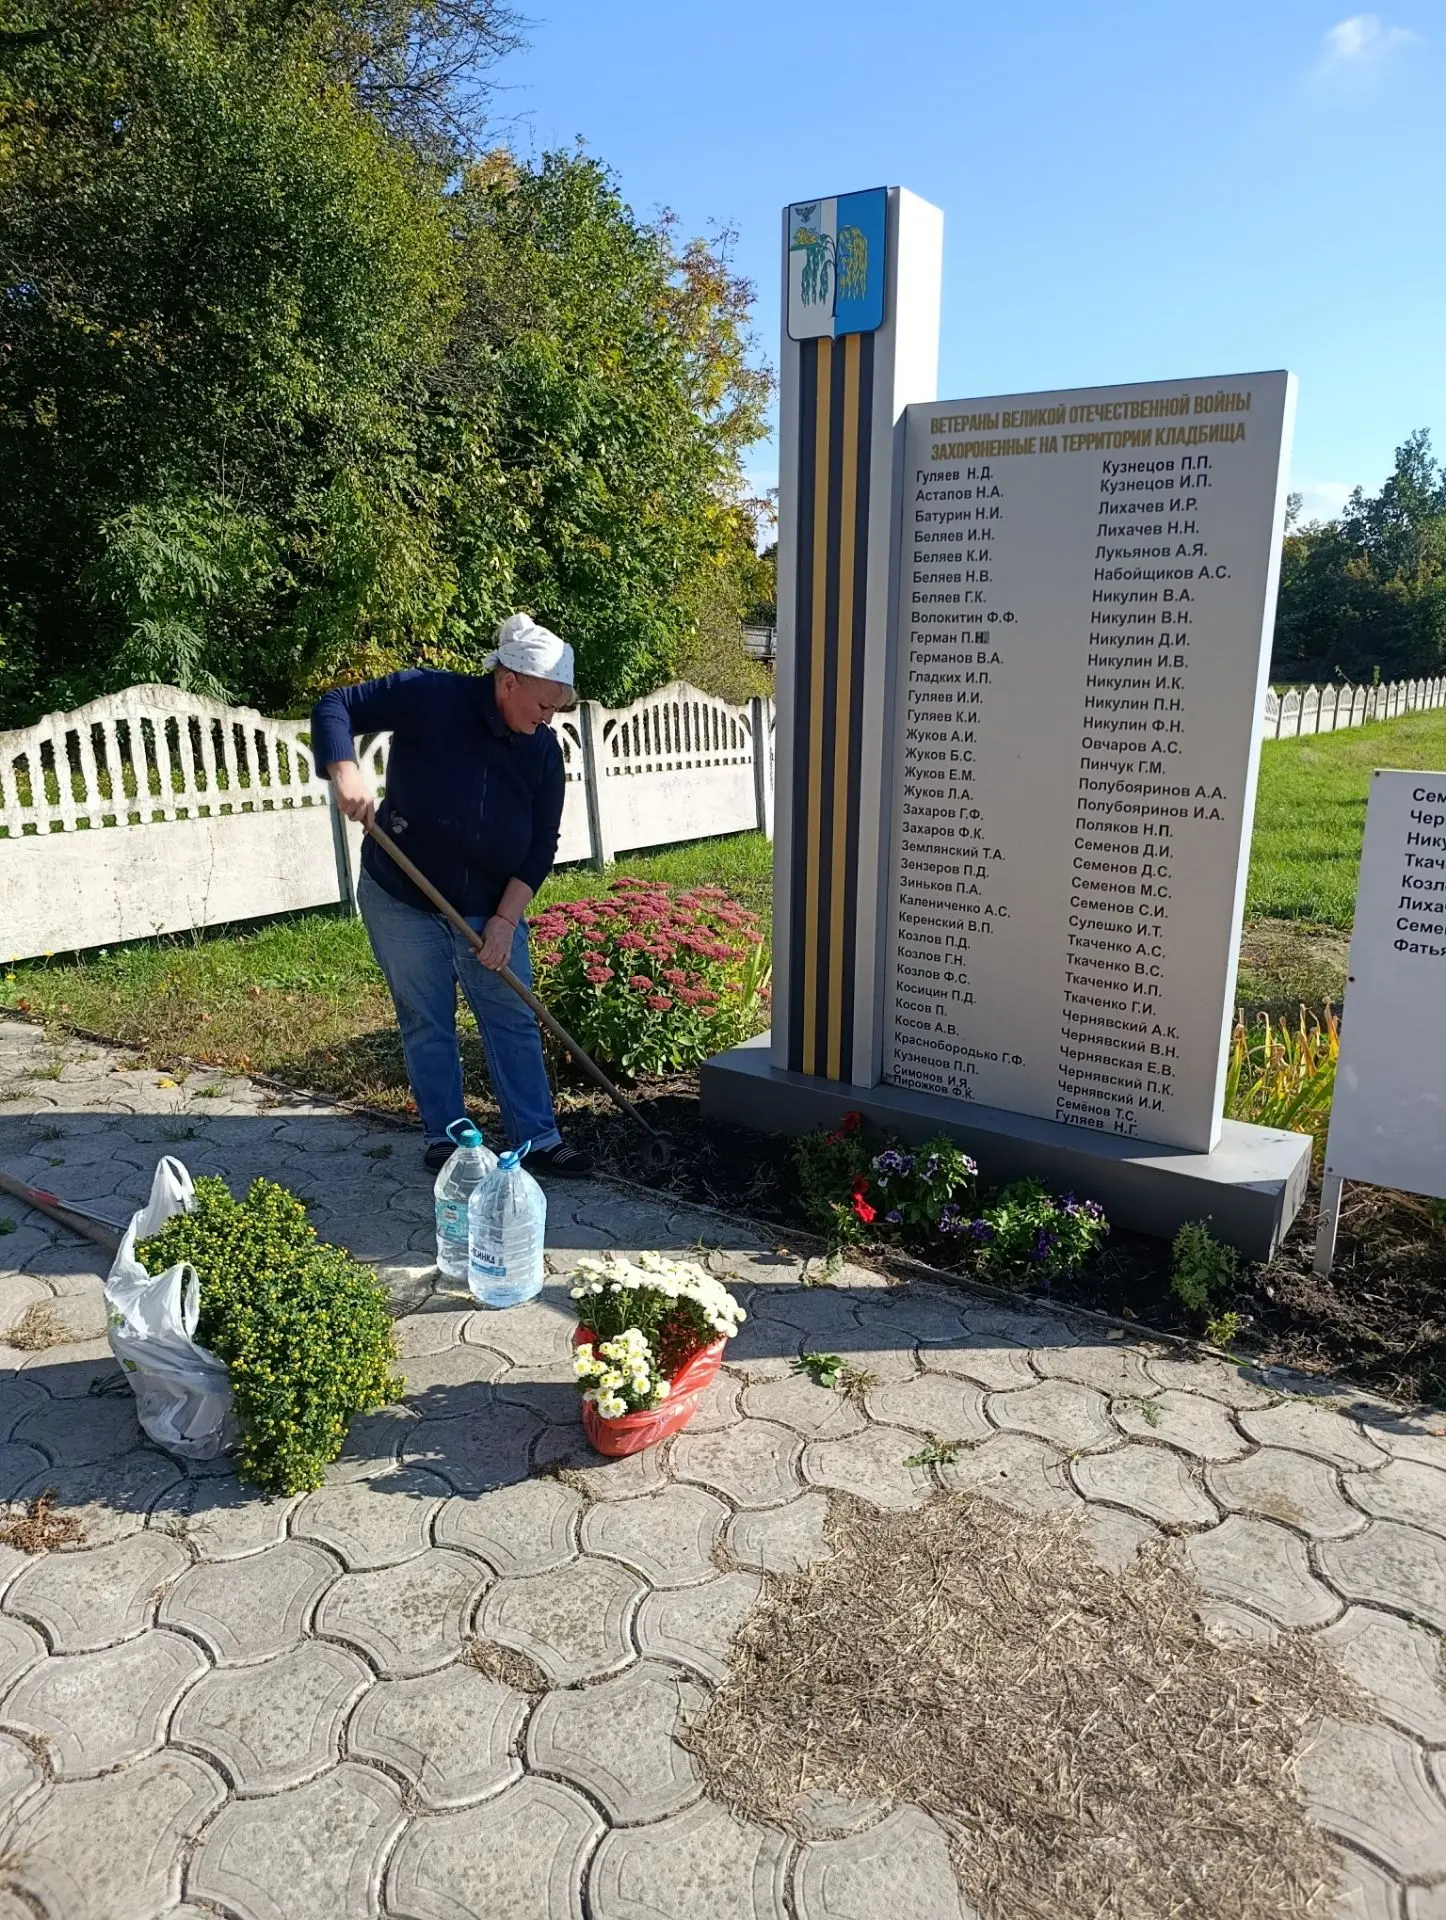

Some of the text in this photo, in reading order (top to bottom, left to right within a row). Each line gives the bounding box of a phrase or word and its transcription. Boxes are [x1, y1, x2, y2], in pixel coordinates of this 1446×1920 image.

[930, 390, 1251, 434] ВЕТЕРАНЫ ВЕЛИКОЙ ОТЕЧЕСТВЕННОЙ ВОЙНЫ
[931, 422, 1246, 460] ЗАХОРОНЕННЫЕ НА ТЕРРИТОРИИ КЛАДБИЩА
[916, 466, 993, 485] Гуляев Н.Д.
[1102, 456, 1212, 477] Кузнецов П.П.
[916, 485, 1004, 501] Астапов Н.А.
[1100, 474, 1212, 495] Кузнецов И.П.
[915, 507, 1003, 524] Батурин Н.И.
[1098, 498, 1198, 515] Лихачев И.Р.
[914, 528, 995, 542] Беляев И.Н.
[1096, 520, 1199, 537] Лихачев Н.Н.
[913, 549, 992, 563] Беляев К.И.
[1095, 543, 1208, 562] Лукьянов А.Я.
[913, 570, 993, 583] Беляев Н.В.
[1094, 565, 1231, 582] Набойщиков А.С.
[912, 591, 986, 603] Беляев Г.К.
[1092, 589, 1195, 605] Никулин В.А.
[911, 611, 1018, 623] Волокитин Ф.Ф.
[1091, 611, 1192, 627] Никулин В.Н.
[910, 631, 987, 645] Герман П.Н.
[1089, 633, 1190, 648] Никулин Д.И.
[909, 651, 1003, 665] Германов В.А.
[1088, 654, 1188, 669] Никулин И.В.
[909, 671, 992, 684] Гладких И.П.
[1086, 675, 1185, 691] Никулин И.К.
[908, 690, 983, 704] Гуляев И.И.
[1085, 696, 1184, 712] Никулин П.Н.
[907, 709, 980, 723] Гуляев К.И.
[1083, 716, 1184, 733] Никулин Ф.Н.
[906, 728, 977, 743] Жуков А.И.
[905, 747, 976, 762] Жуков Б.С.
[1082, 737, 1182, 754] Овчаров А.С.
[905, 766, 976, 780] Жуков Е.М.
[1080, 757, 1165, 774] Пинчук Г.М.
[904, 784, 974, 800] Жуков Л.А.
[1079, 778, 1227, 799] Полубояринов А.А.
[903, 803, 983, 820] Захаров Г.Ф.
[1077, 798, 1225, 821] Полубояринов И.А.
[1076, 818, 1173, 837] Поляков Н.П.
[1410, 810, 1446, 828] Чер
[902, 821, 984, 840] Захаров Ф.К.
[902, 840, 1006, 860] Землянский Т.А.
[1074, 837, 1173, 858] Семенов Д.И.
[901, 858, 989, 879] Зензеров П.Д.
[1073, 857, 1172, 879] Семенов Д.С.
[1404, 853, 1446, 870] Ткач
[900, 876, 982, 895] Зиньков П.А.
[1072, 877, 1172, 899] Семенов М.С.
[1402, 874, 1446, 892] Козл
[899, 894, 1010, 918] Калениченко А.С.
[1070, 896, 1168, 919] Семенов С.И.
[1398, 896, 1446, 913] Лиха
[899, 912, 994, 934] Керенский В.П.
[1069, 915, 1163, 938] Сулешко И.Т.
[1396, 917, 1446, 935] Семе
[898, 929, 971, 949] Козлов П.Д.
[1068, 934, 1165, 958] Ткаченко А.С.
[897, 946, 966, 966] Козлов Г.Н.
[897, 963, 970, 985] Козлов Ф.С.
[1066, 953, 1163, 978] Ткаченко В.С.
[896, 981, 976, 1004] Косицин П.Д.
[1065, 971, 1162, 997] Ткаченко И.П.
[895, 998, 948, 1016] Косов П.
[1063, 990, 1156, 1016] Ткаченко Г.И.
[895, 1015, 959, 1036] Косов А.В.
[1063, 1008, 1180, 1039] Чернявский А.К.
[894, 1032, 1026, 1067] Краснобородько Г.Ф.
[1061, 1027, 1180, 1058] Чернявский В.Н.
[1060, 1045, 1175, 1077] Чернявская Е.В.
[1059, 1063, 1174, 1096] Чернявский П.К.
[1058, 1080, 1165, 1112] Чернявский И.И.
[1055, 1109, 1138, 1136] Гуляев Н.Г.
[1115, 1108, 1137, 1122] Т.С.
